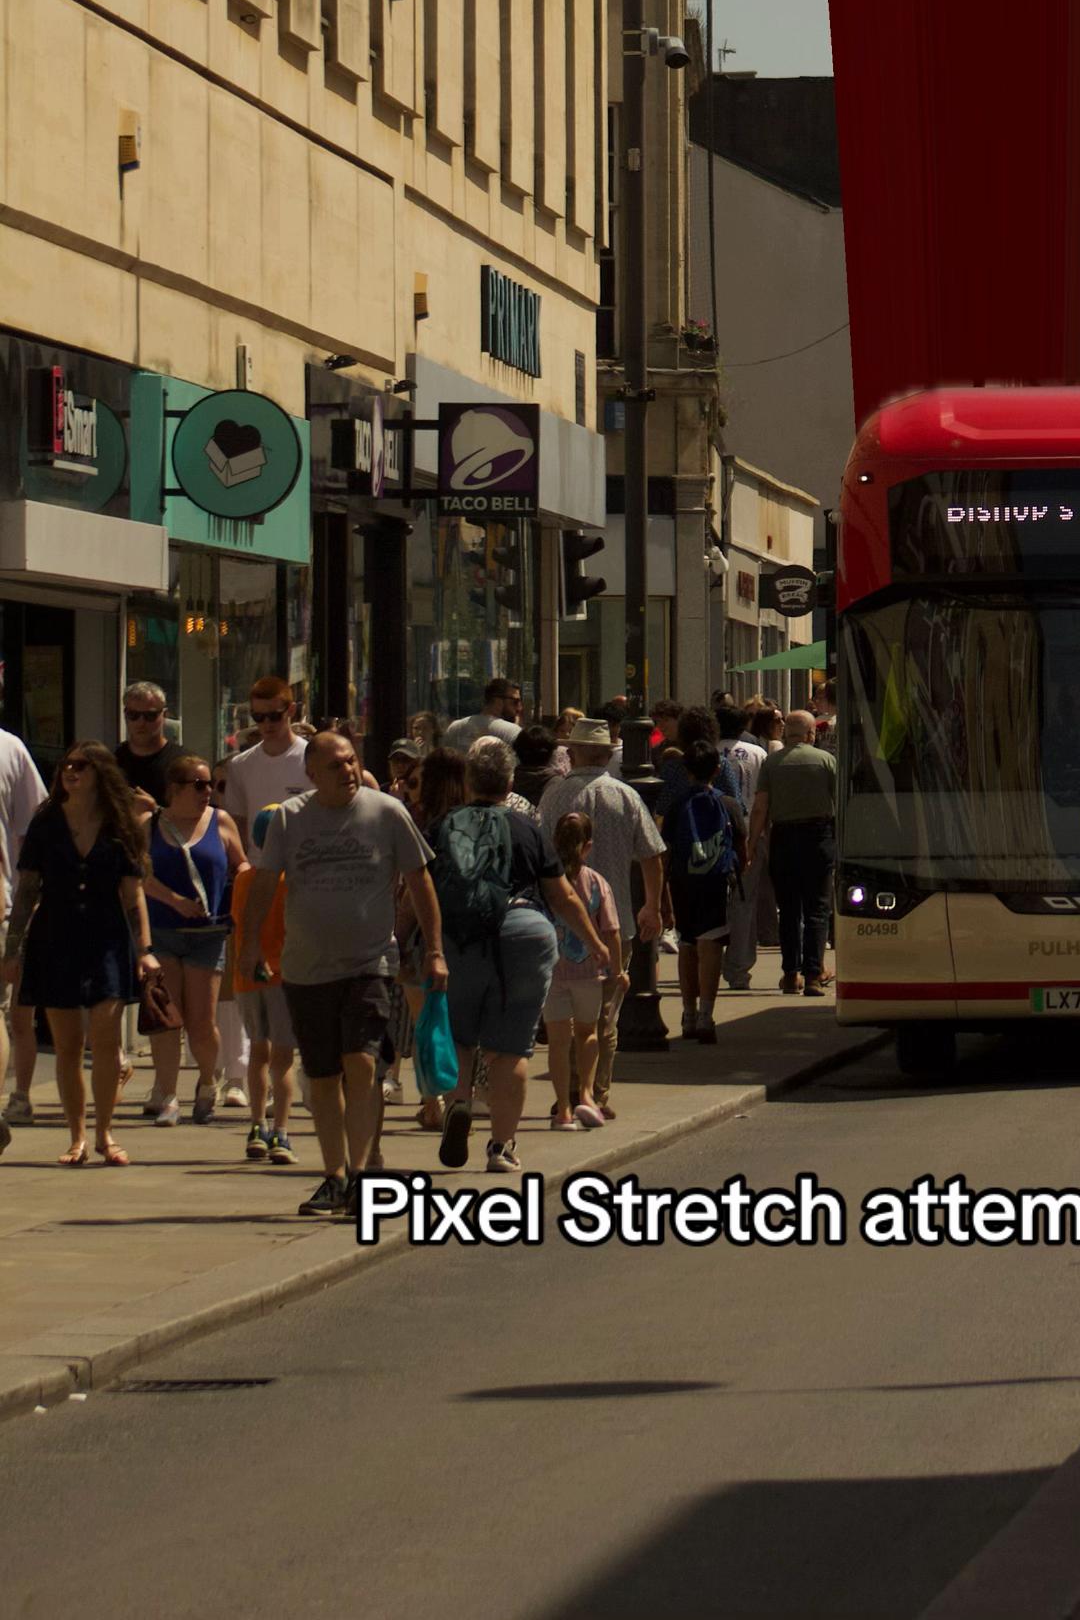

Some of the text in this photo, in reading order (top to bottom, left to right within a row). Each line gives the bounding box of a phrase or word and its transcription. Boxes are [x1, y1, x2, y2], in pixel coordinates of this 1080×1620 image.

[482, 265, 541, 378] PRIMARK
[354, 417, 399, 481] TACO BELL
[439, 496, 534, 511] TACO BELL
[857, 923, 898, 936] 80498
